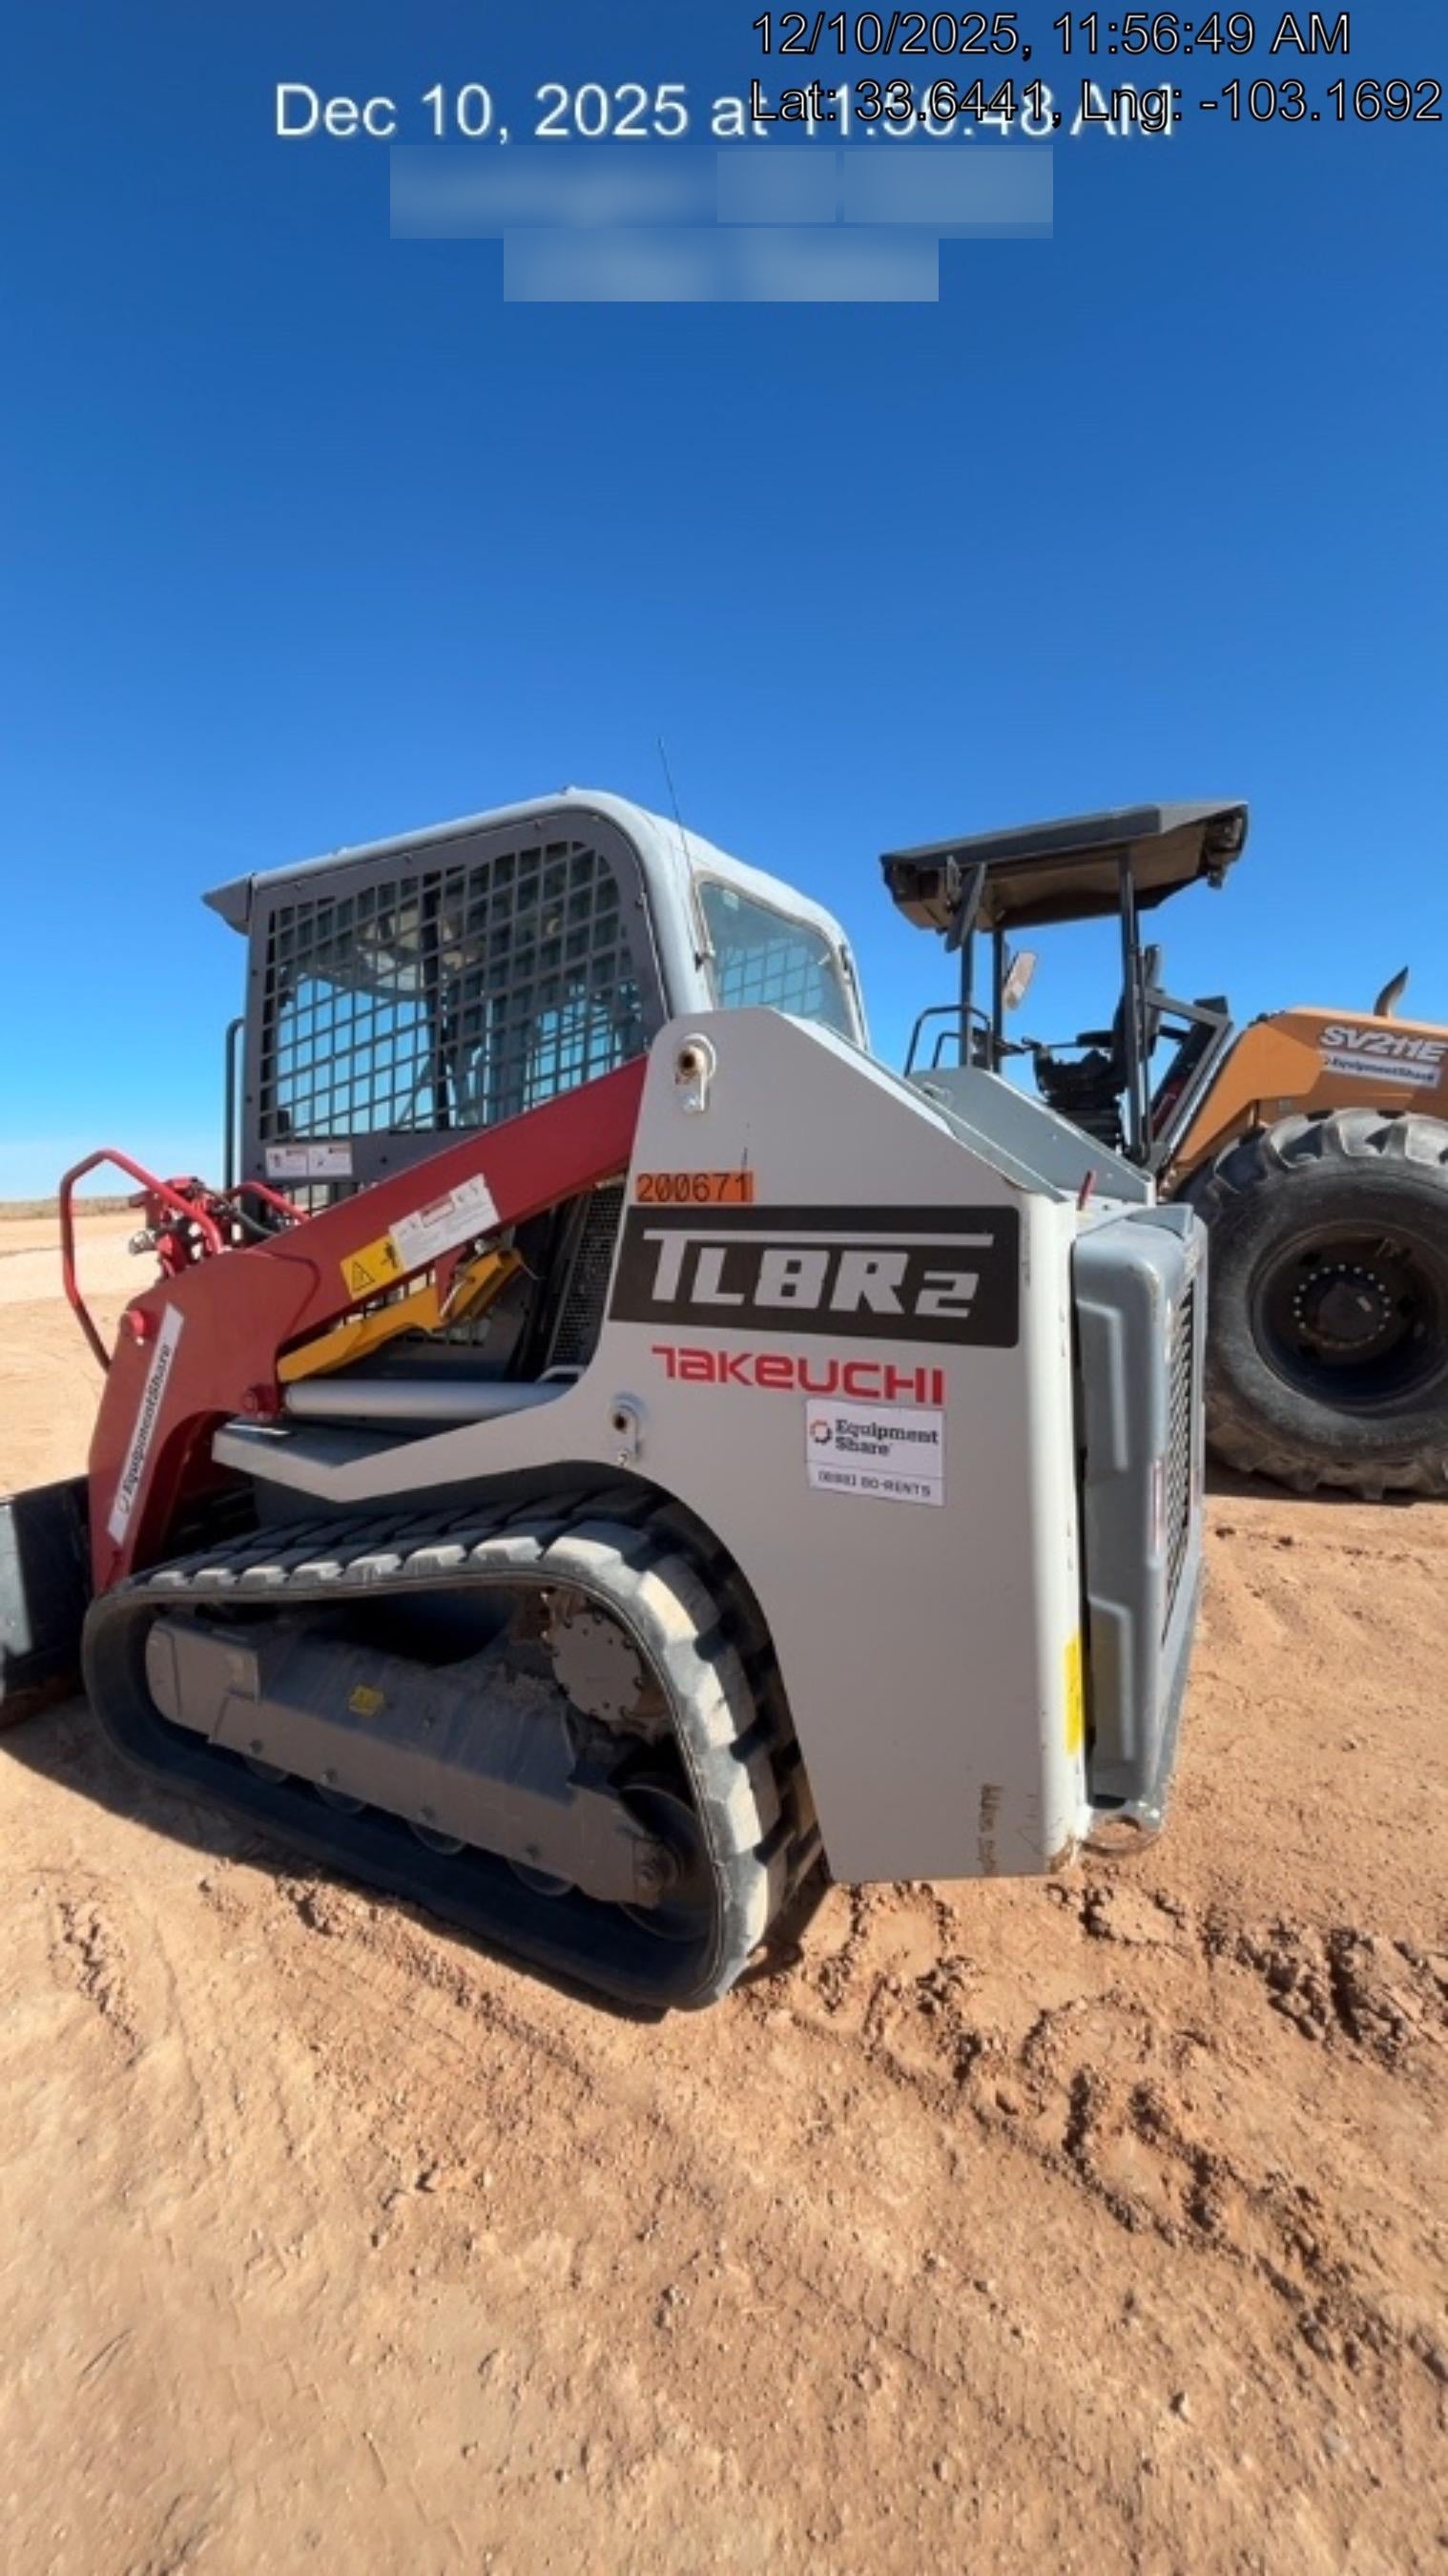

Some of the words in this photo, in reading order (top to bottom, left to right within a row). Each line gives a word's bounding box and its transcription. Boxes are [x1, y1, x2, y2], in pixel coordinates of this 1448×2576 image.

[1320, 1025, 1448, 1062] SV211E
[637, 1172, 749, 1203] 200671
[643, 1229, 994, 1319] TL8R2
[835, 1419, 939, 1444] Equipment
[835, 1435, 890, 1457] Share
